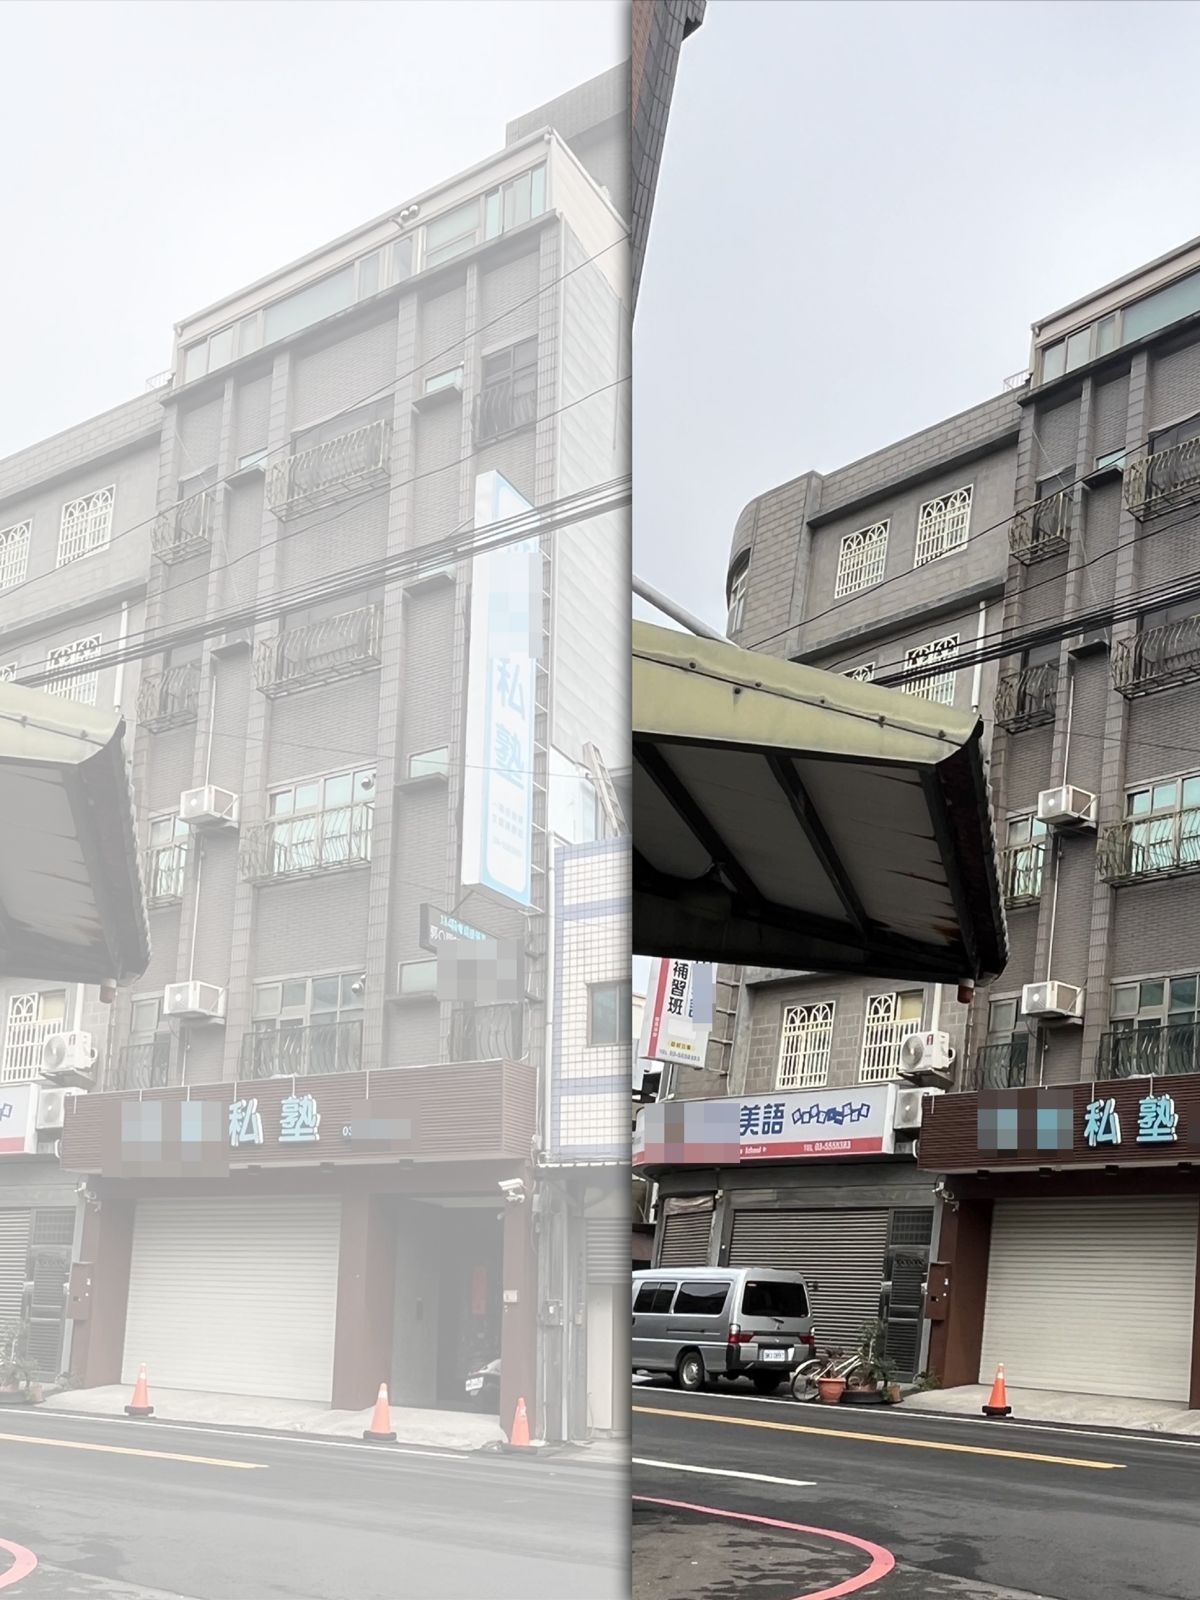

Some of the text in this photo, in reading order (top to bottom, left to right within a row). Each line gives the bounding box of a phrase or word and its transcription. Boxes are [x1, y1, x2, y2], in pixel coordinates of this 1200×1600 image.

[667, 960, 689, 1015] 補習班
[229, 1094, 320, 1147] 私塾
[740, 1103, 785, 1136] 美語
[1084, 1094, 1179, 1147] 私塾
